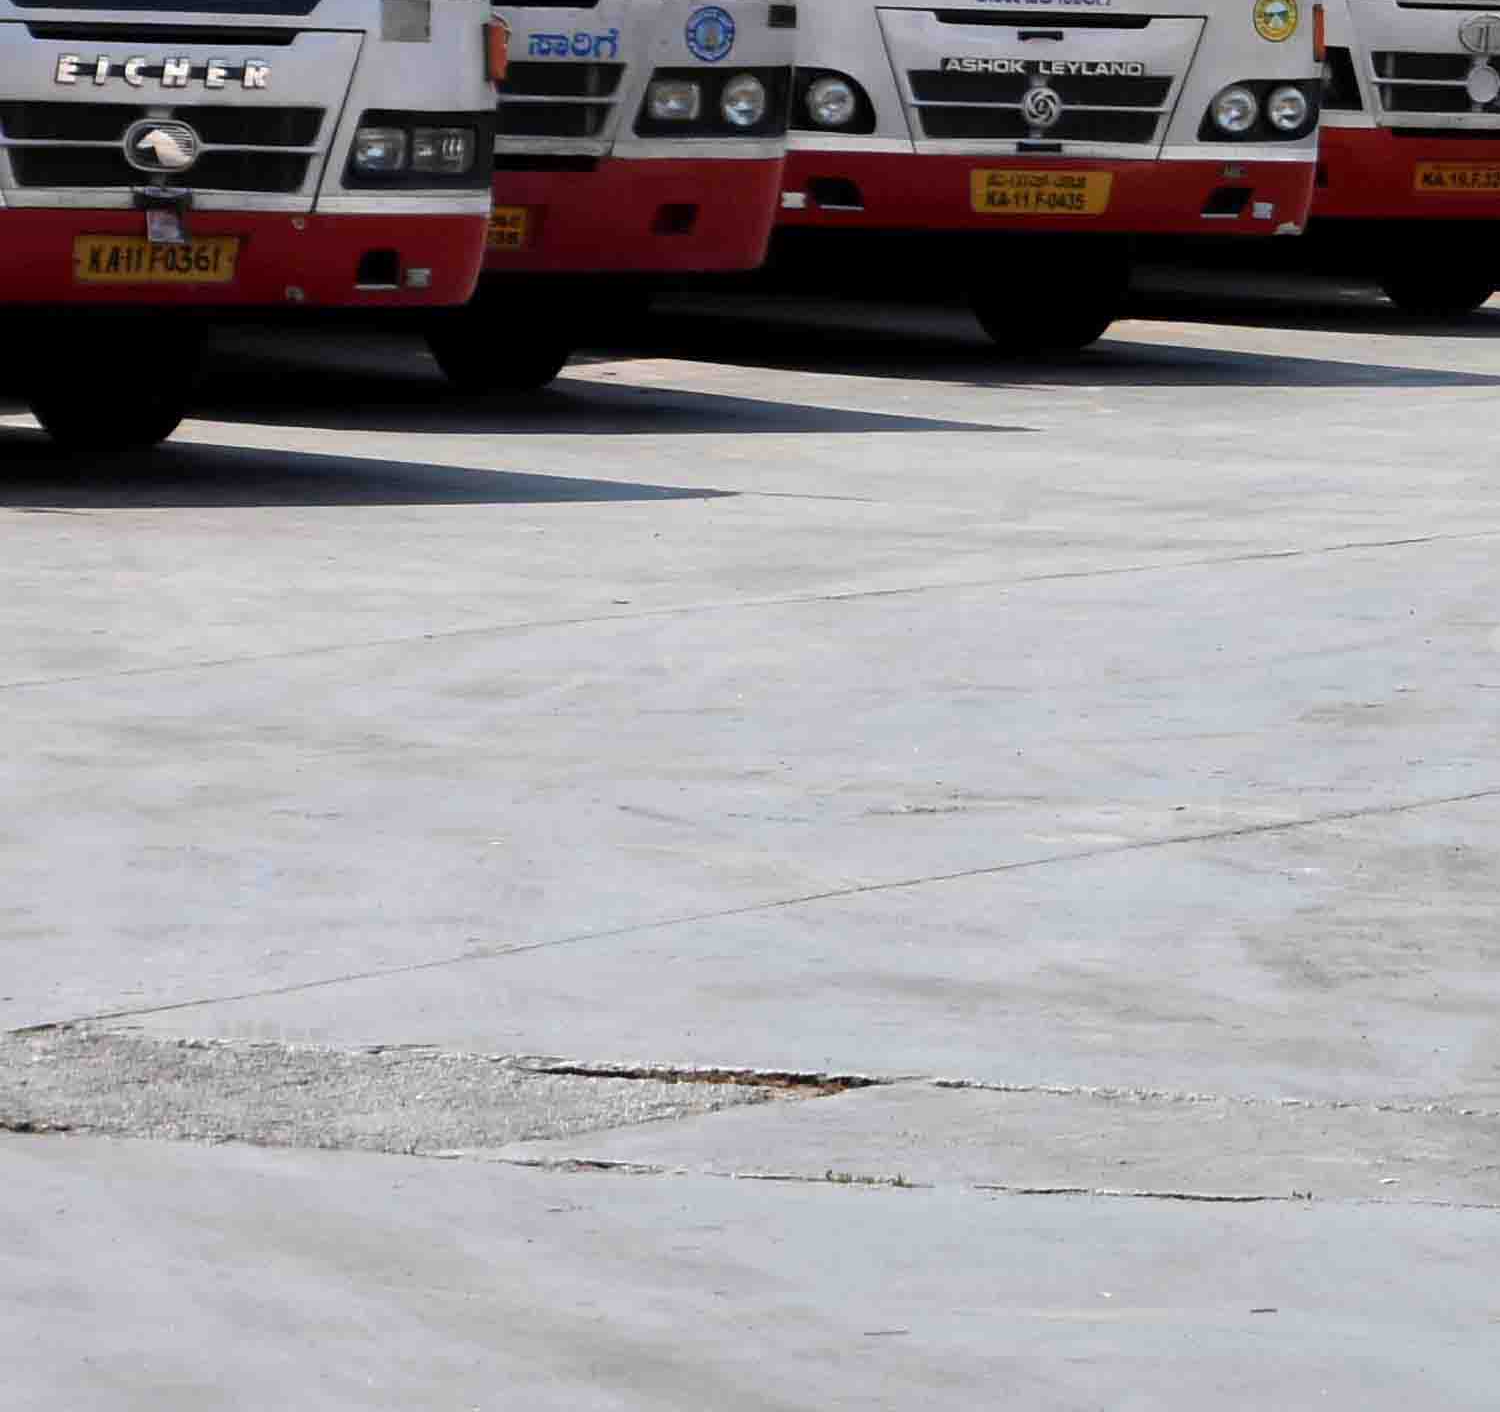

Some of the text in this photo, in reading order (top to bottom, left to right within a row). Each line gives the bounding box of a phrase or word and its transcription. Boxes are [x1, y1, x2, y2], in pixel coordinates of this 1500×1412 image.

[54, 54, 273, 91] EICHER
[944, 58, 1145, 77] ASHOK LEYLAND
